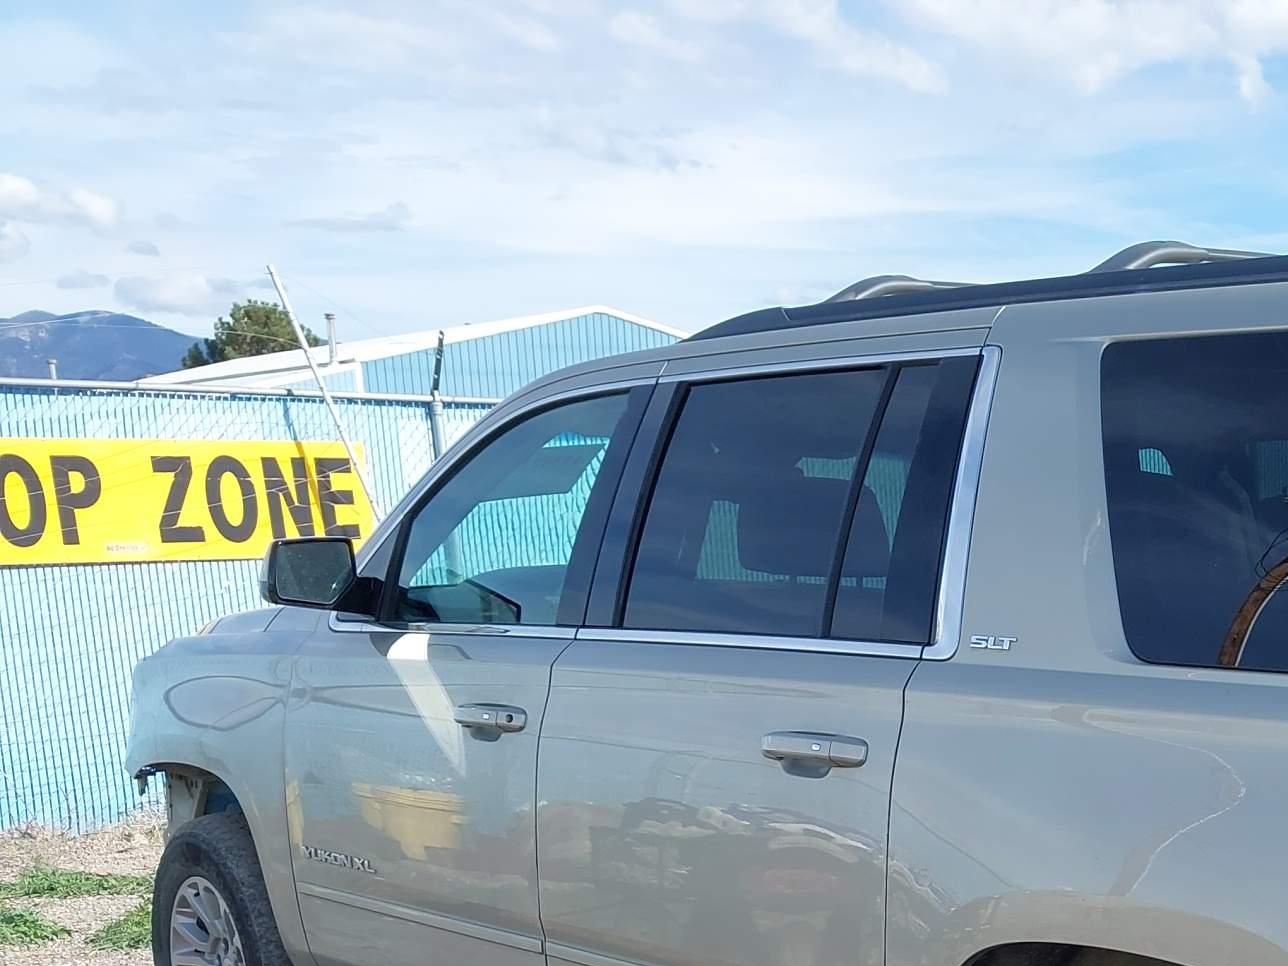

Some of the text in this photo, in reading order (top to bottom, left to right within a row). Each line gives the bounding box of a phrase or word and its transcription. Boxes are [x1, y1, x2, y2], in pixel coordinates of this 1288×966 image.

[150, 455, 361, 544] ZONE
[969, 634, 1018, 651] SLT
[302, 845, 377, 874] YUKON XL
